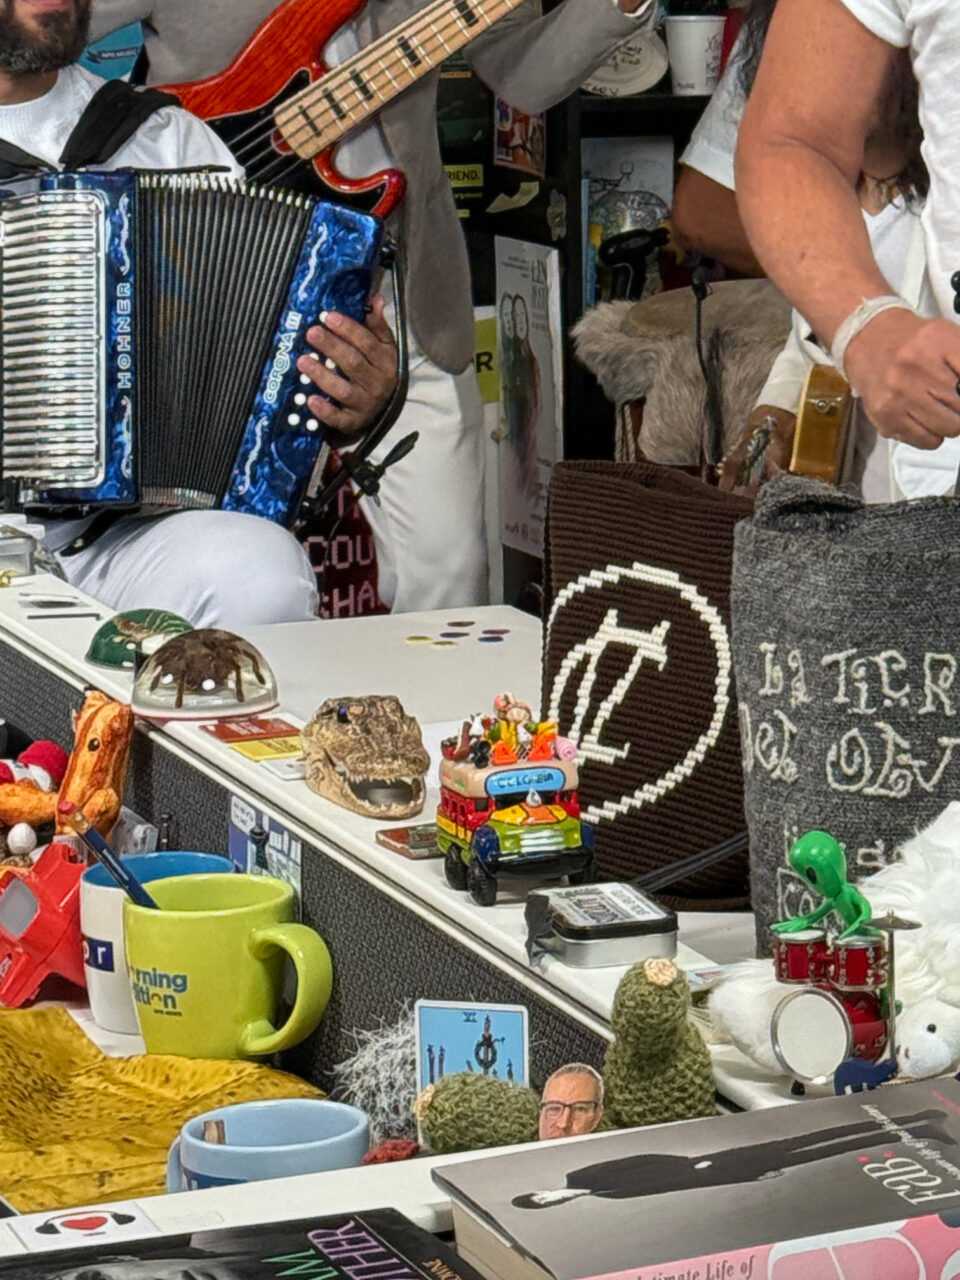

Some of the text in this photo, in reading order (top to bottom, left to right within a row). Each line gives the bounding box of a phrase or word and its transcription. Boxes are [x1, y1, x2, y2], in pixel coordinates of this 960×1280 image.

[117, 281, 132, 389] HOHNER
[263, 331, 295, 404] CORONA
[705, 1259, 737, 1280] Life
[738, 1255, 757, 1280] of
